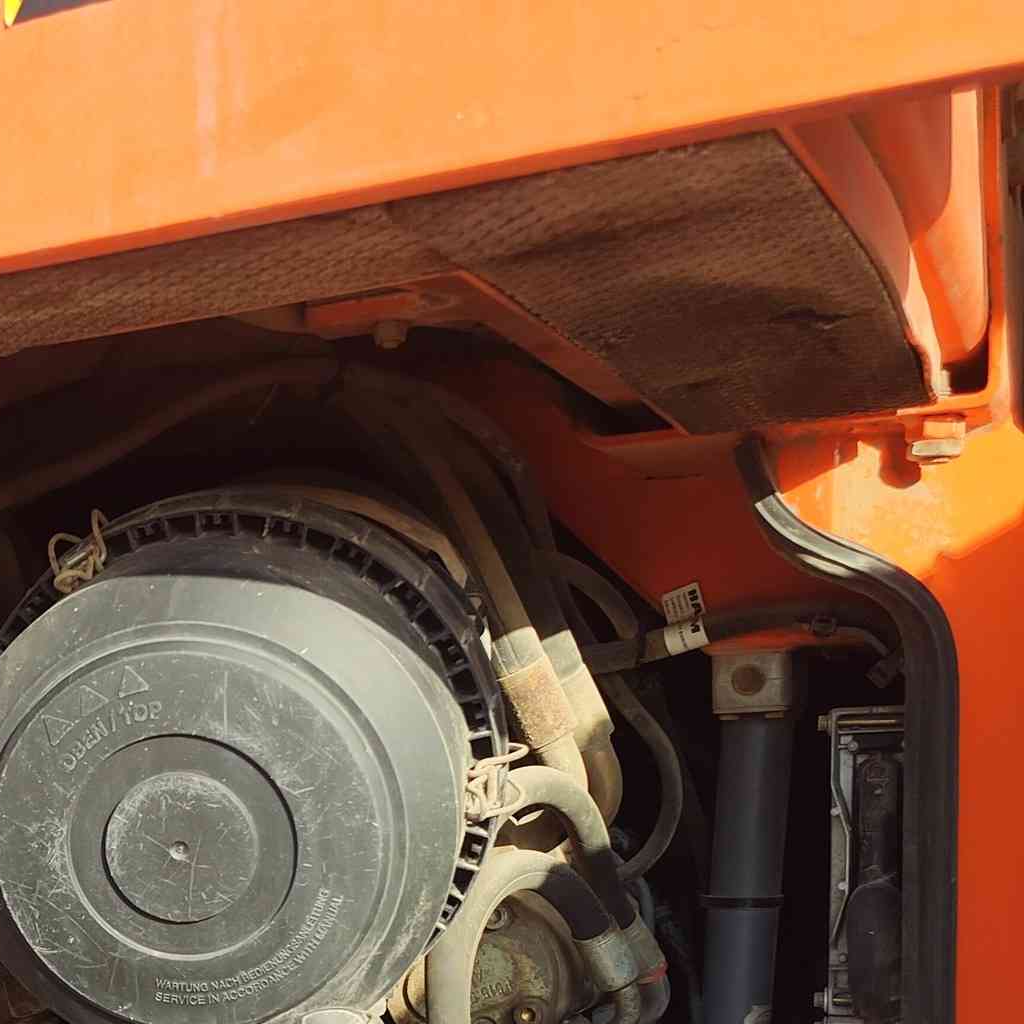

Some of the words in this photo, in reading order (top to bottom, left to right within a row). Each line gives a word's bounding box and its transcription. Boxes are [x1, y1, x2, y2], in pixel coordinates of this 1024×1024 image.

[154, 991, 207, 1006] SERVICE
[207, 992, 220, 1005] IN
[222, 961, 298, 1002] ACCORDANCE
[293, 938, 320, 965] WITH
[315, 894, 344, 941] MANUAL
[155, 977, 208, 994] WARTUNG
[210, 976, 240, 991] NACH
[240, 887, 329, 984] BEDIENUNGSANLEITUNG
